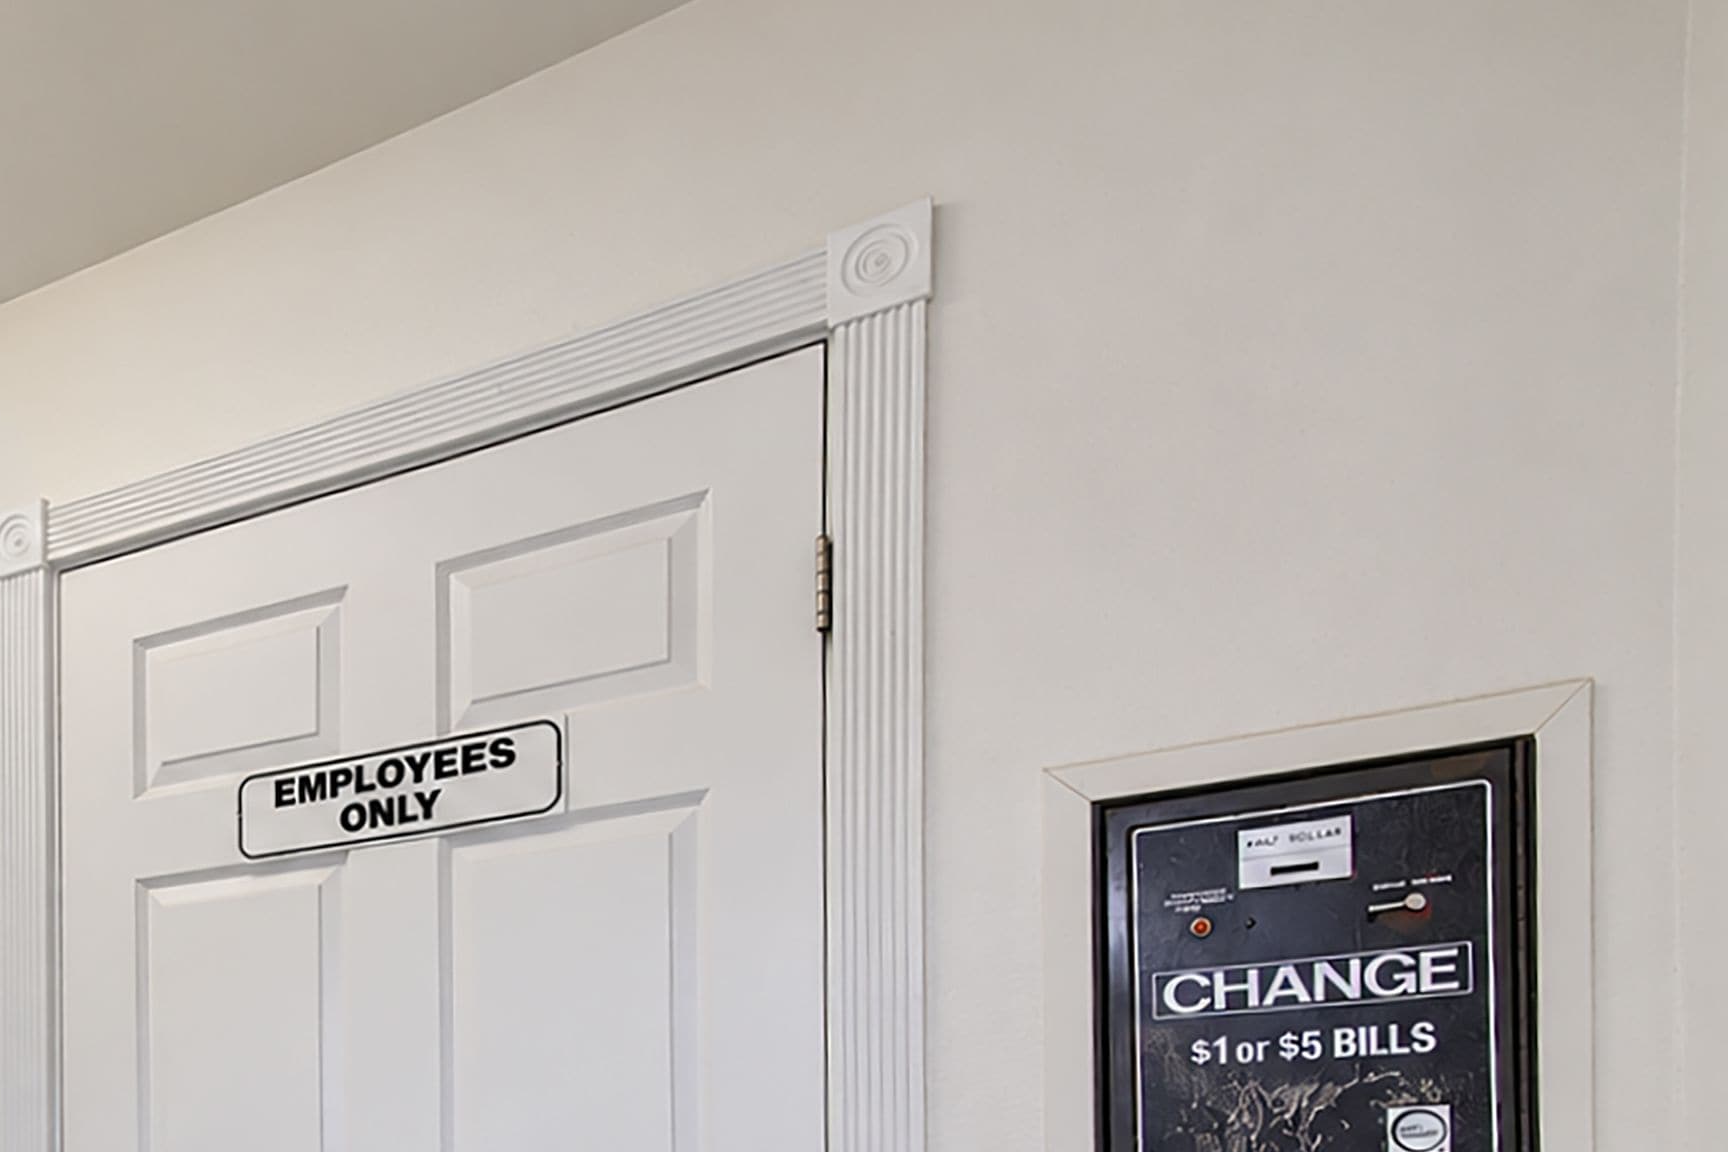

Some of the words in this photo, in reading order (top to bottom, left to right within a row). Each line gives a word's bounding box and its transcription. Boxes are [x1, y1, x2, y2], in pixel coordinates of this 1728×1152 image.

[274, 738, 516, 808] EMPLOYEES
[340, 789, 441, 831] ONLY
[1163, 949, 1460, 1013] CHANGE
[1191, 1036, 1227, 1064] $1
[1236, 1041, 1270, 1063] or
[1279, 1031, 1322, 1061] $5
[1334, 1022, 1437, 1058] BILLS
